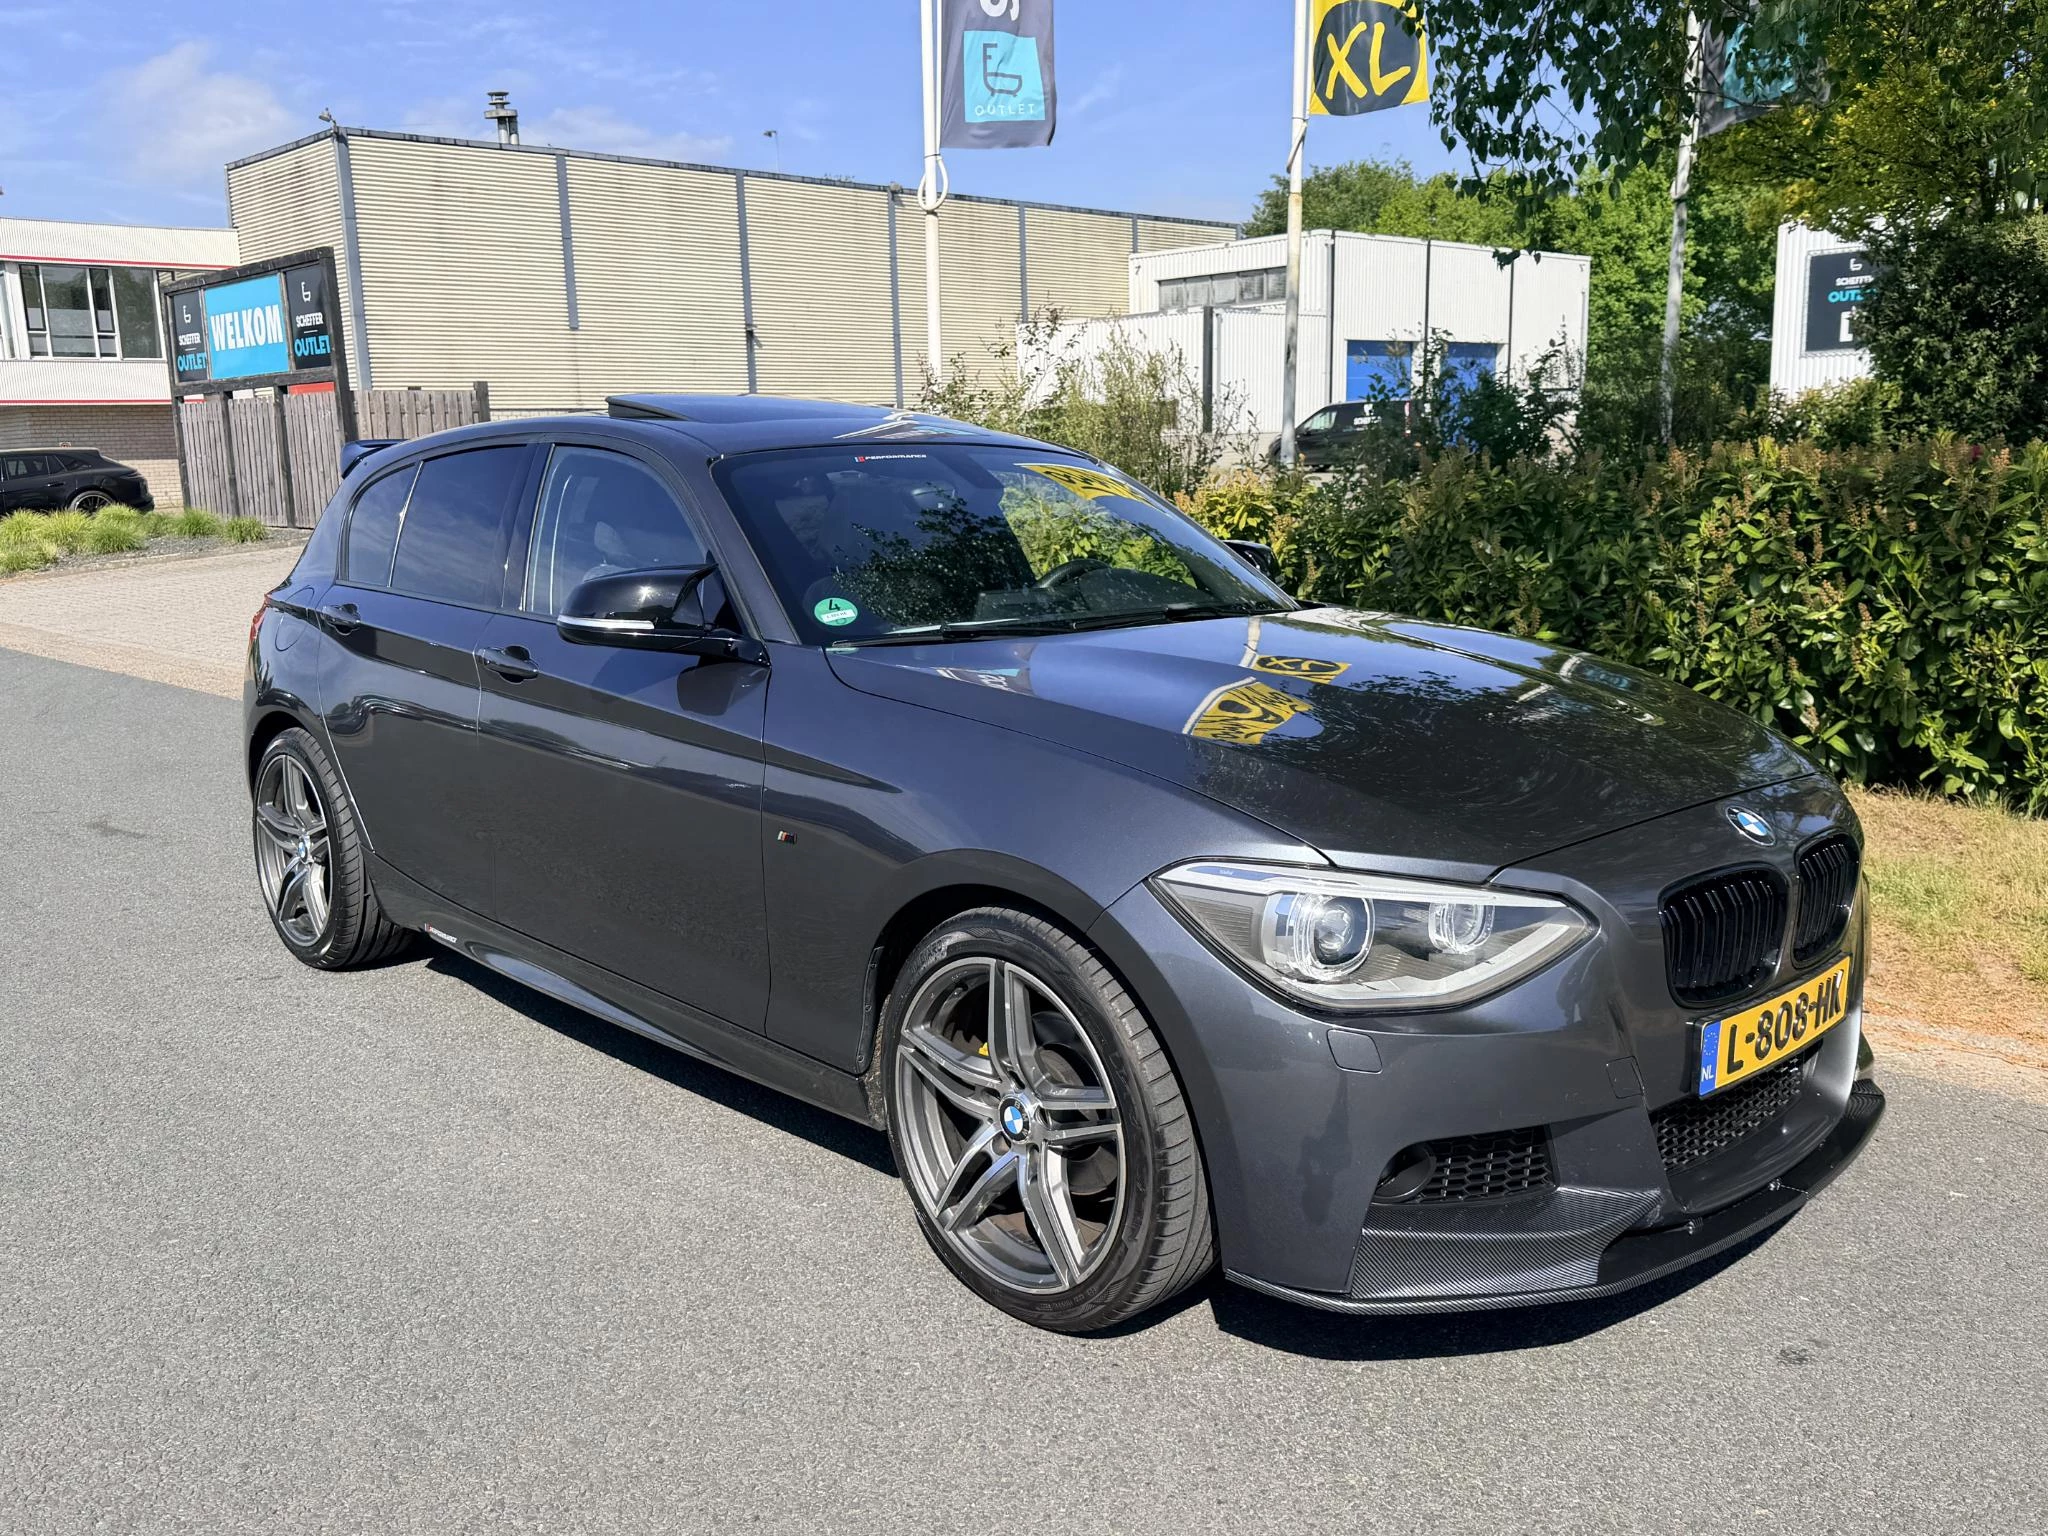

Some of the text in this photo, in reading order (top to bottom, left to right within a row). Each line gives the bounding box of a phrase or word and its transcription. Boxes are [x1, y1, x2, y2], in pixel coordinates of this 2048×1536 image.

[1325, 21, 1411, 100] XL
[975, 103, 1035, 116] OUTLET
[210, 304, 284, 352] WELKOM
[295, 312, 324, 327] SCHEFFER
[178, 332, 201, 346] SCHEFFER
[294, 335, 330, 357] OUTLET
[177, 352, 207, 372] OUTLET
[829, 599, 840, 611] 4
[1727, 968, 1845, 1075] L-808-HK
[1701, 1063, 1715, 1083] NL
